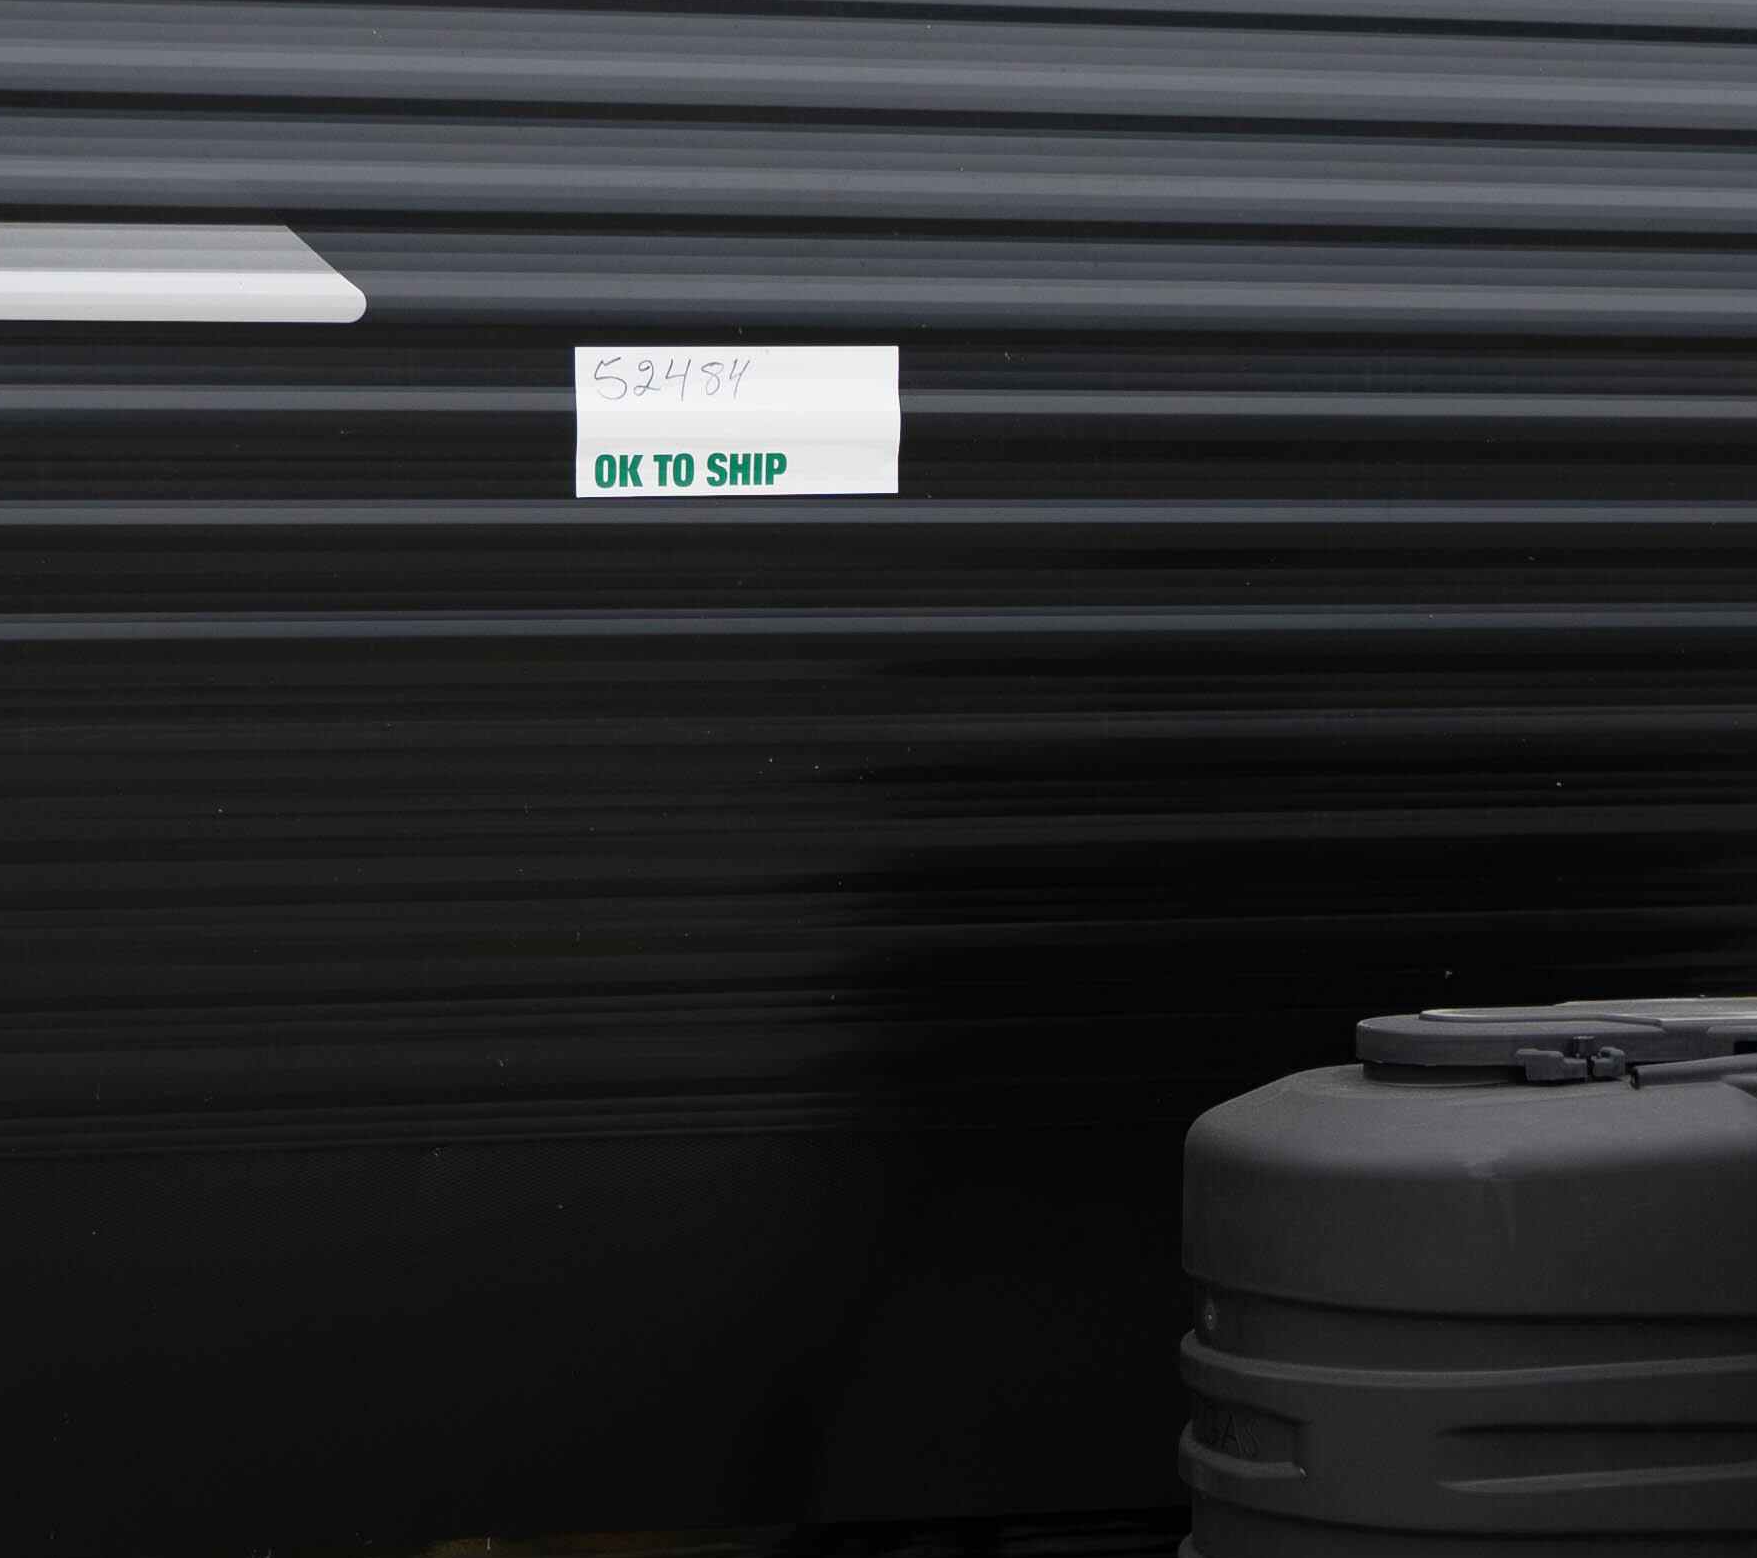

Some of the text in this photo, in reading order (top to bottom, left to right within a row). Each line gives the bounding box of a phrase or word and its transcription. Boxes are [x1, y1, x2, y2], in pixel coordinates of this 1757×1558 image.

[594, 356, 750, 402] 52484
[594, 452, 788, 489] OK TO SHIP
